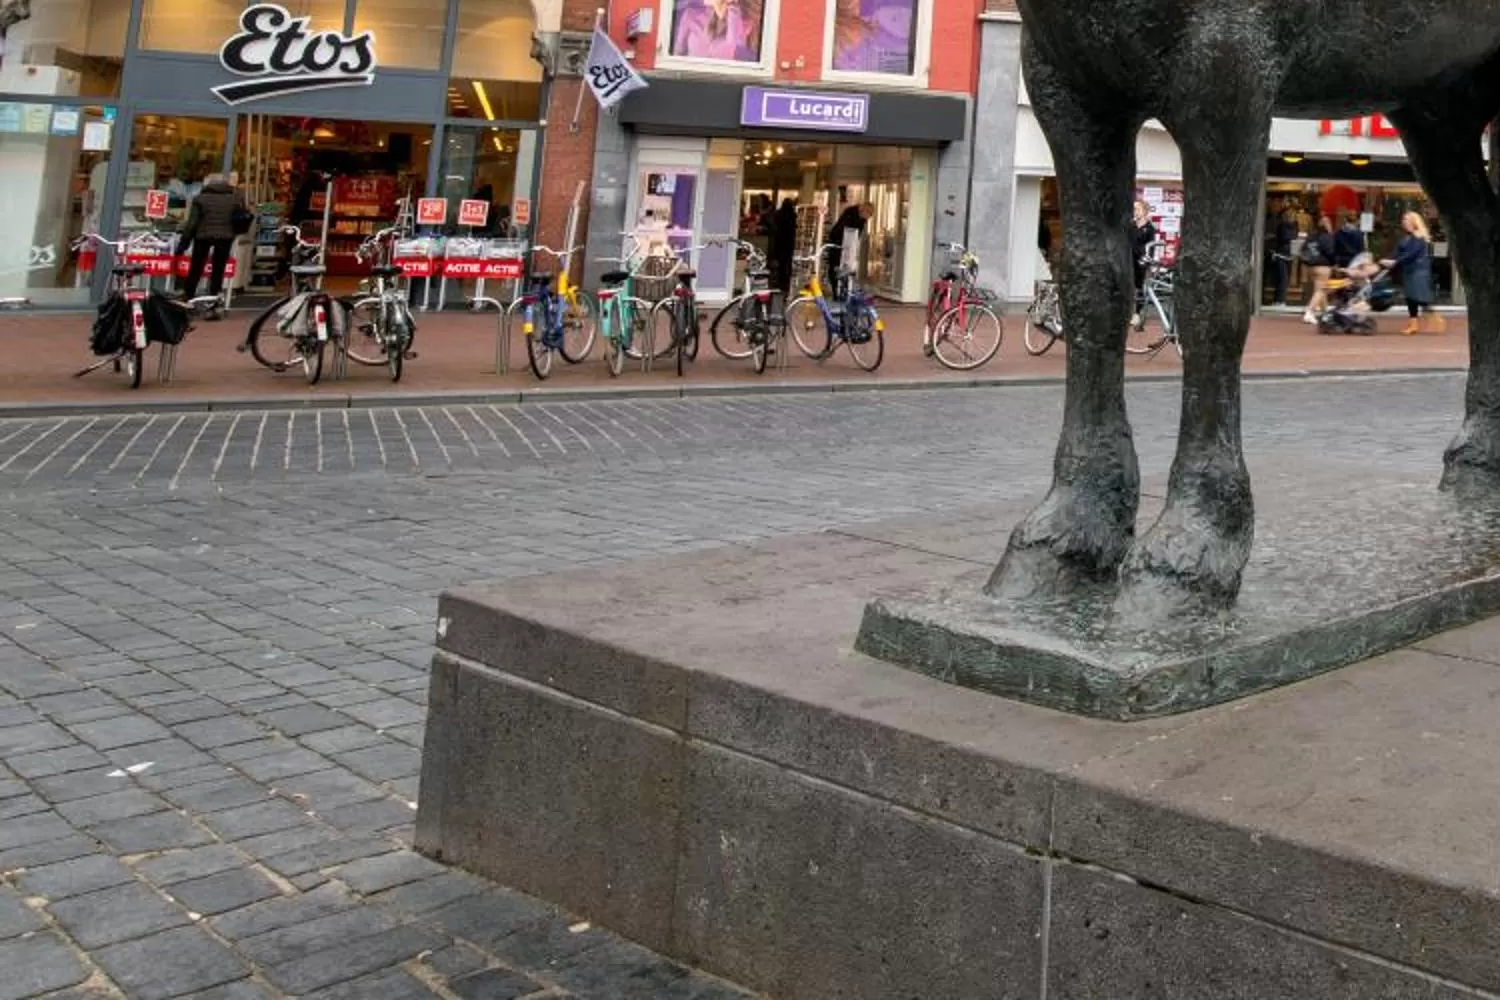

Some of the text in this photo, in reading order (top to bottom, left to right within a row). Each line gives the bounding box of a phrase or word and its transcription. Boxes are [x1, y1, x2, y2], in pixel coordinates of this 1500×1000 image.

[220, 2, 375, 75] Etos
[589, 62, 629, 89] Etos
[790, 99, 860, 117] Lucardi
[446, 263, 519, 274] ACTIE ACTIE
